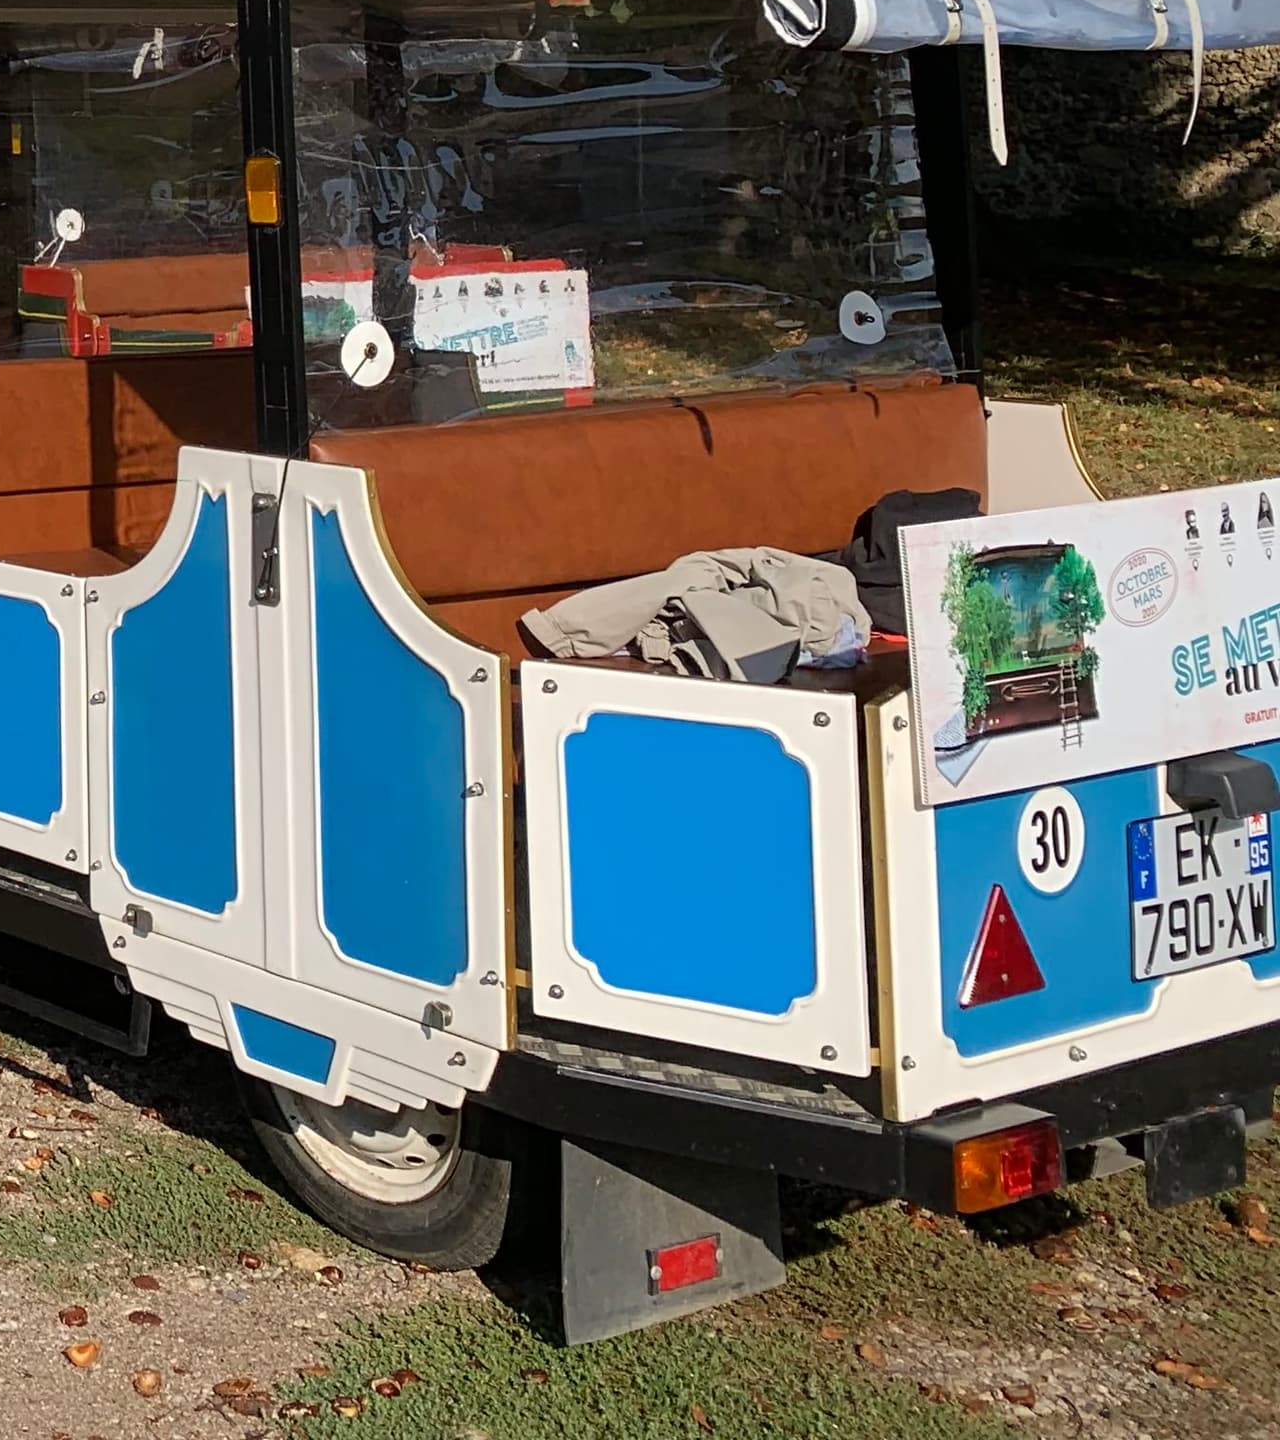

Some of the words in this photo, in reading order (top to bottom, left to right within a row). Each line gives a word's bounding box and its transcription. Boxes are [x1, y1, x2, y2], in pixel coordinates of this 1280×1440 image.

[1116, 561, 1169, 596] OCTOBRE
[1133, 584, 1163, 609] MARS
[1172, 633, 1217, 696] SE
[1225, 663, 1262, 696] au
[1244, 707, 1278, 724] GRATUIT
[1030, 806, 1072, 874] 30
[1250, 840, 1269, 868] 95
[1140, 870, 1149, 889] F
